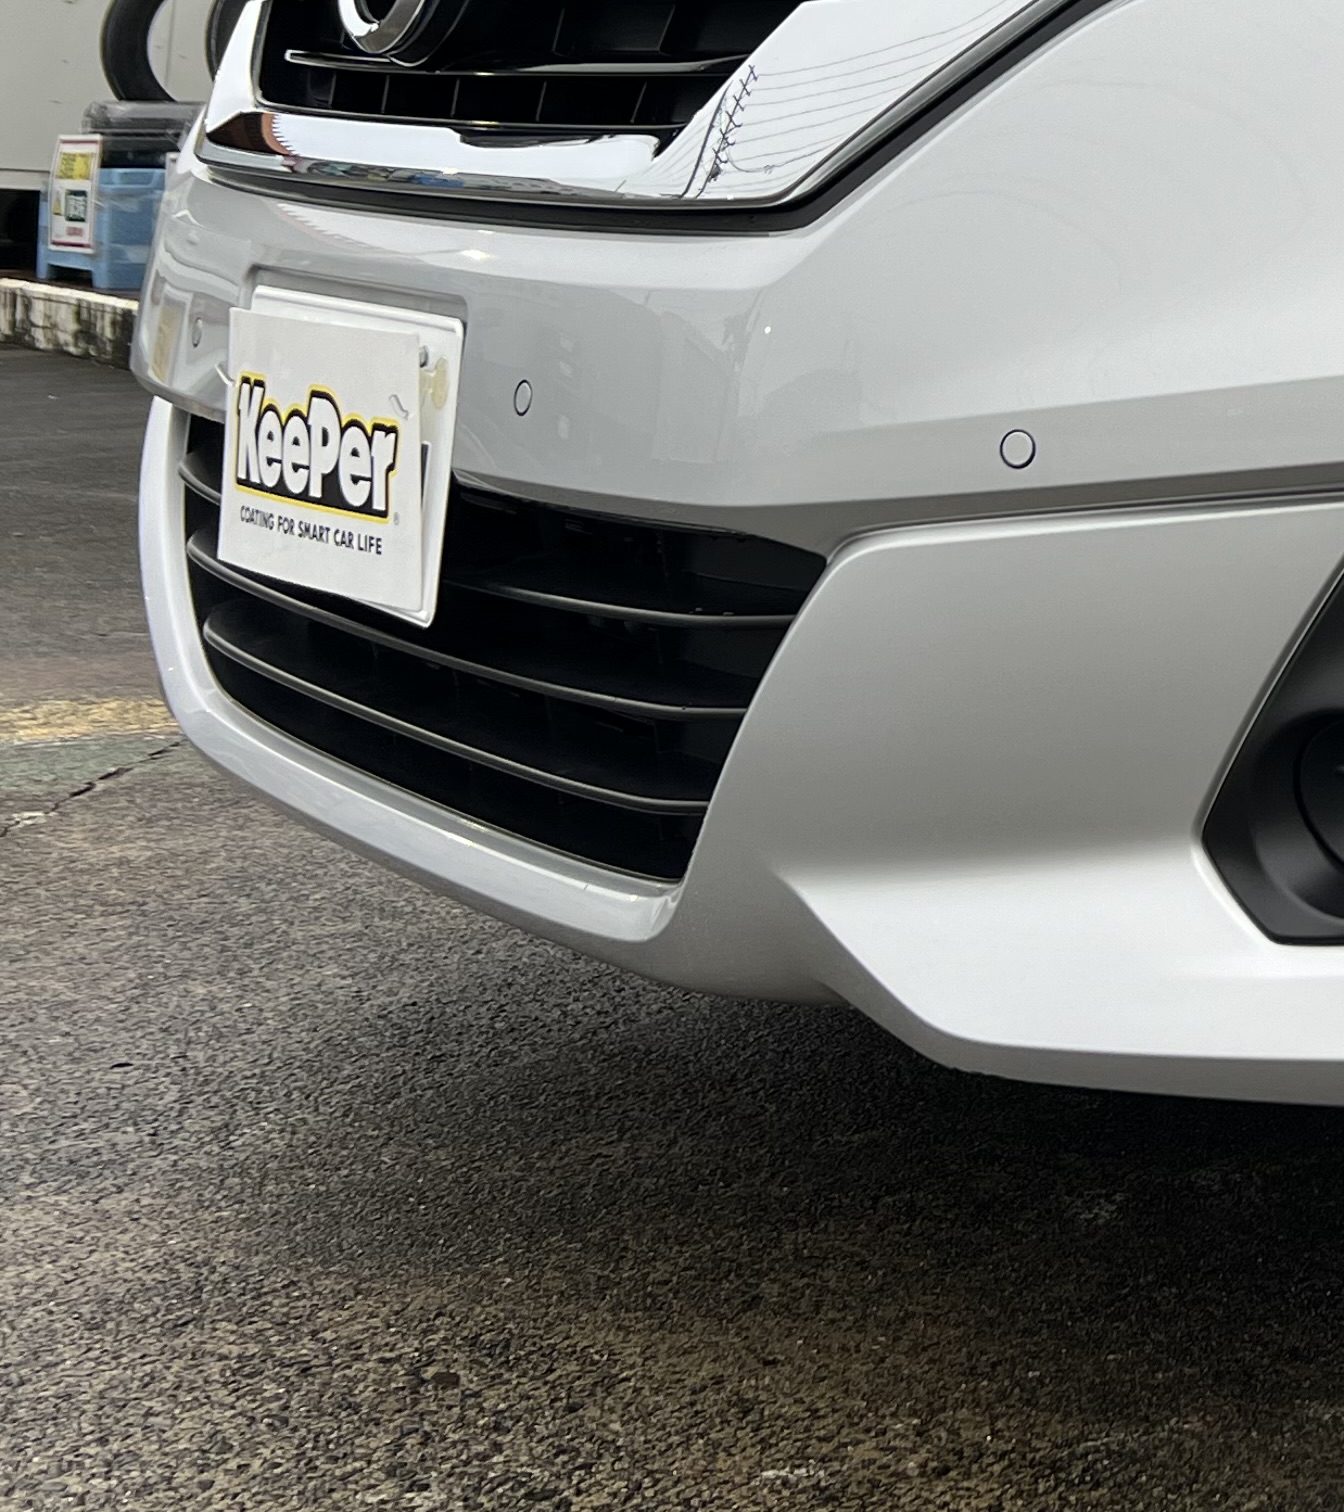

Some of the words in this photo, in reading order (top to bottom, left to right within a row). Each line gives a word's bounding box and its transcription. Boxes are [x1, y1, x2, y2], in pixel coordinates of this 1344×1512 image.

[236, 374, 399, 519] KeePer
[240, 504, 275, 531] COATING
[277, 515, 296, 536] FOR
[297, 520, 331, 545] SMART
[333, 528, 355, 550] CAR
[357, 533, 383, 556] LIFE
